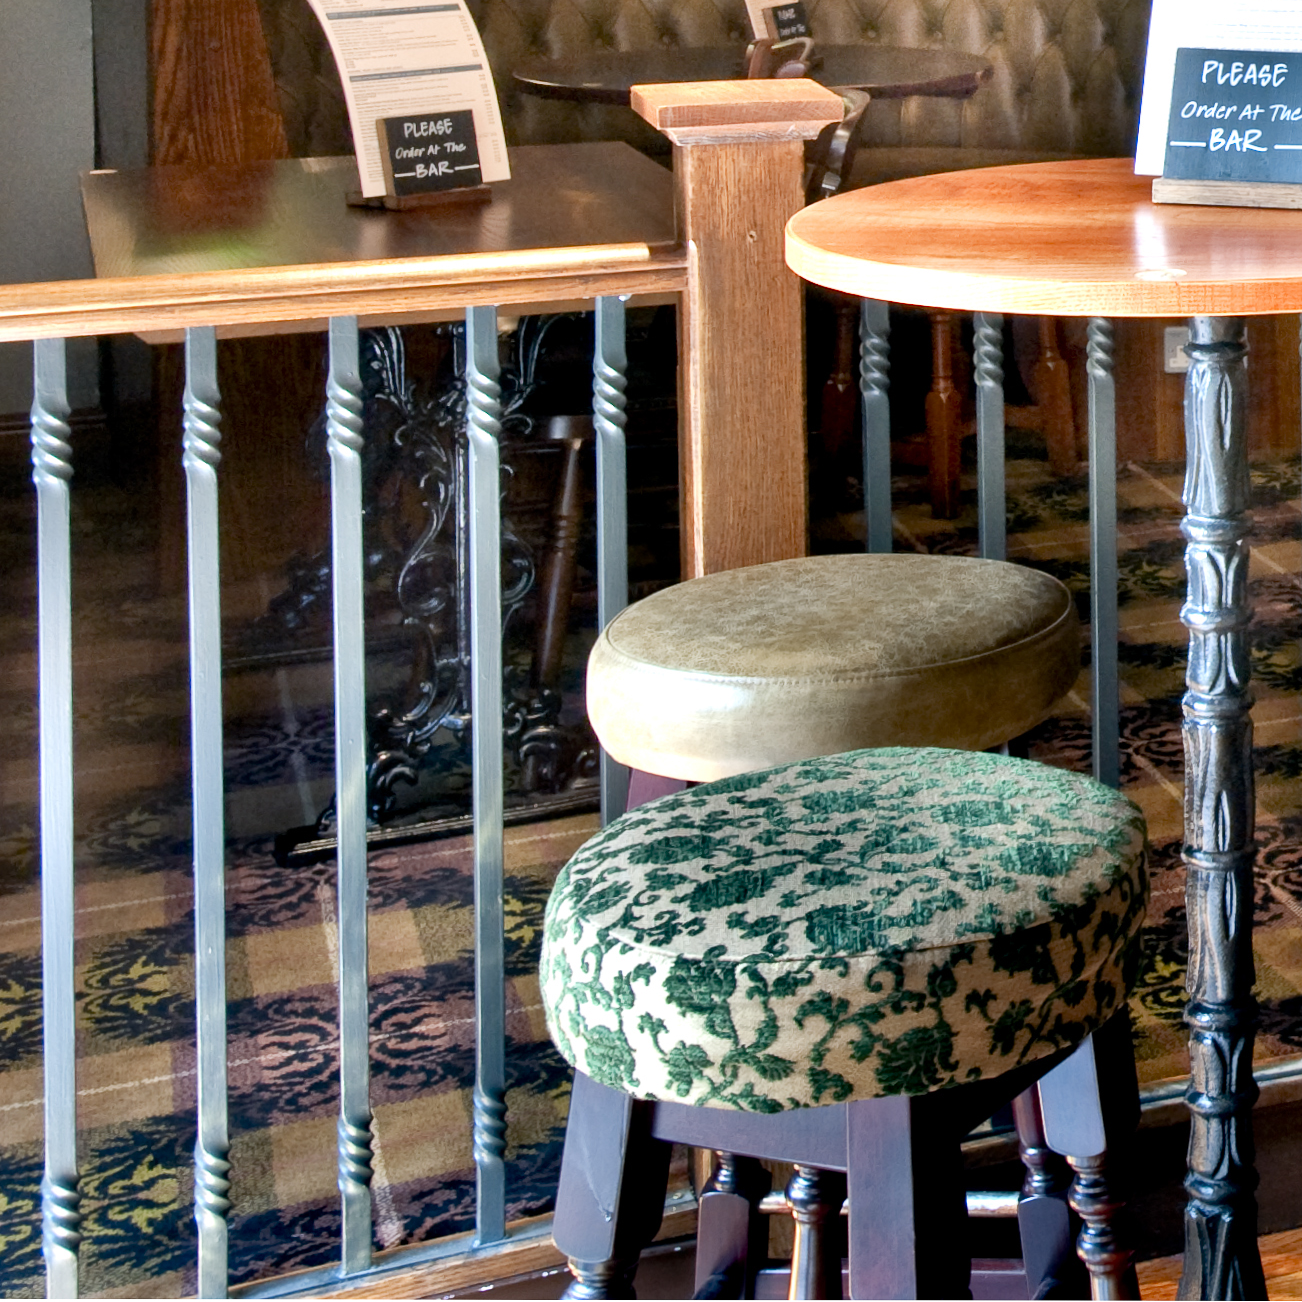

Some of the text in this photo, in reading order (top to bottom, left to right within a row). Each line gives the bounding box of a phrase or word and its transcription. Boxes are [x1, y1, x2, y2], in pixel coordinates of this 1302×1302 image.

[1201, 60, 1289, 87] PLEASE
[1180, 101, 1237, 120] Order
[1238, 102, 1265, 120] At
[403, 118, 453, 138] PLEASE
[1209, 128, 1268, 152] BAR
[395, 141, 467, 159] Order At The
[415, 161, 455, 178] BAR
